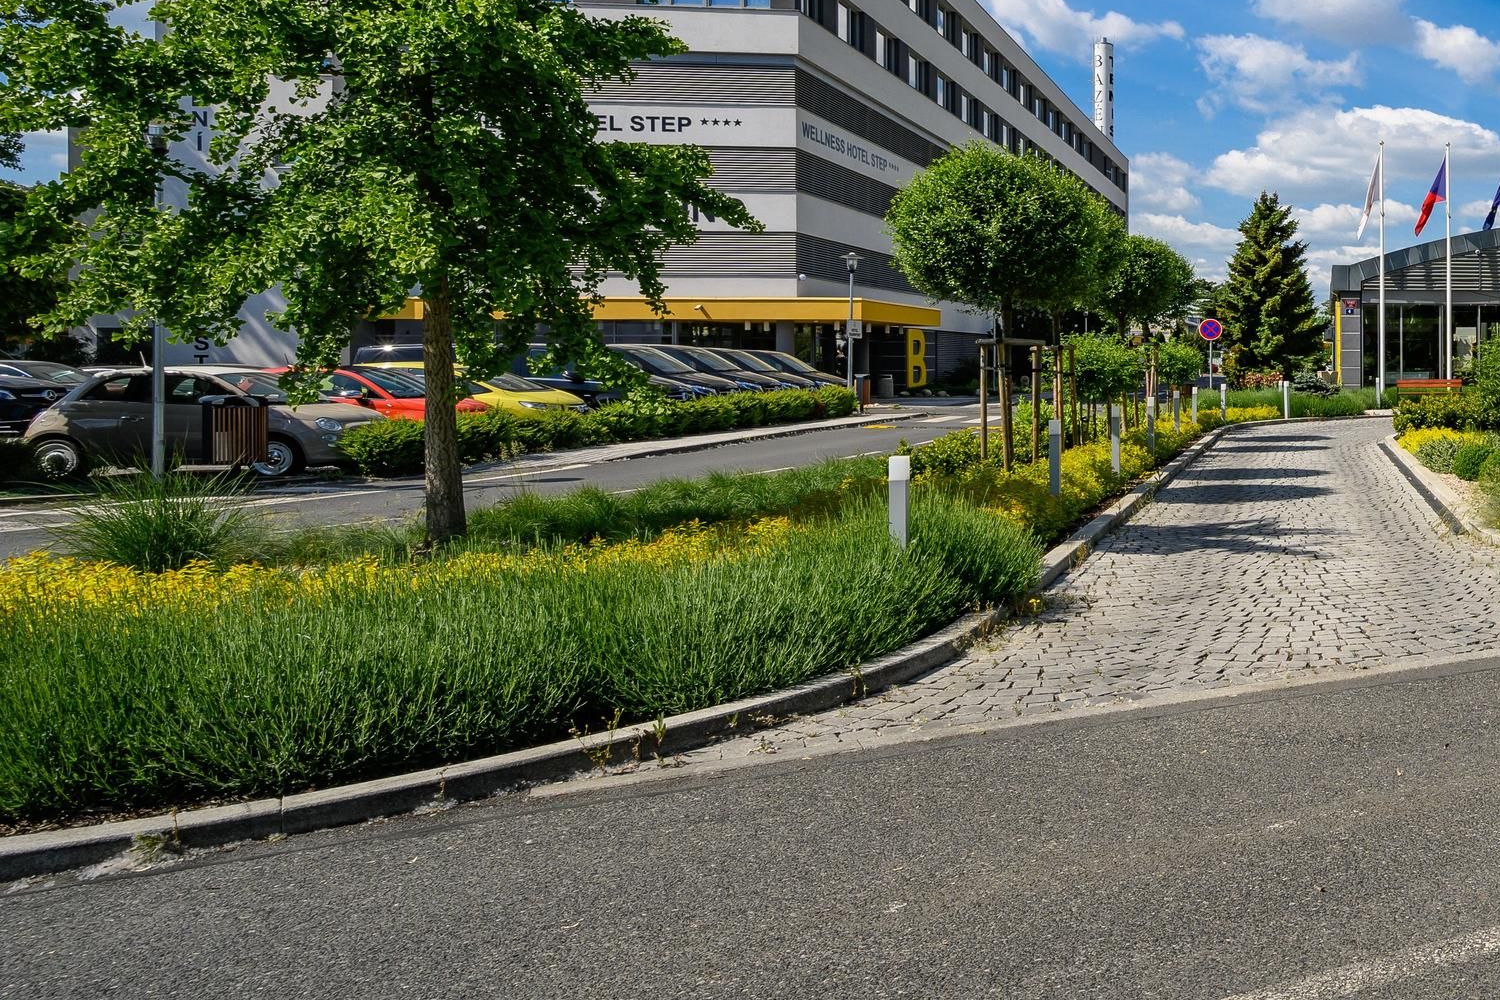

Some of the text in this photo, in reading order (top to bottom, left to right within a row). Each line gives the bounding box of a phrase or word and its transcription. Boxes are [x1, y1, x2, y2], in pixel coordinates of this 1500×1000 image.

[629, 115, 692, 133] STEP
[802, 121, 887, 171] WELLNESS HOTEL STEP
[906, 328, 927, 389] B
